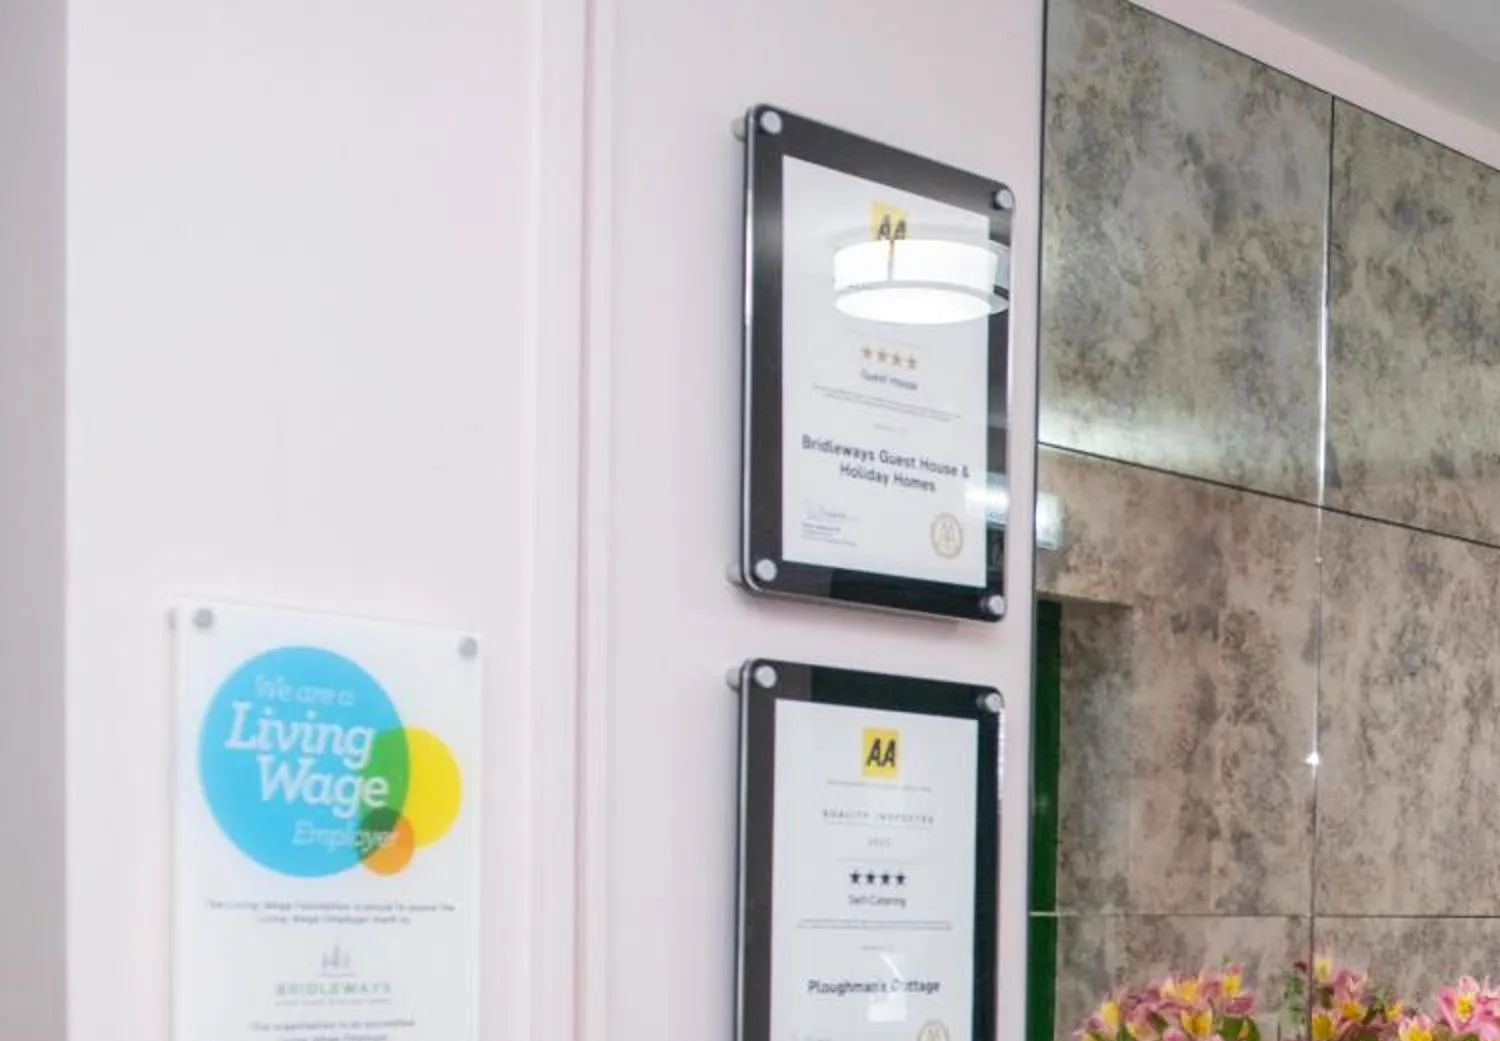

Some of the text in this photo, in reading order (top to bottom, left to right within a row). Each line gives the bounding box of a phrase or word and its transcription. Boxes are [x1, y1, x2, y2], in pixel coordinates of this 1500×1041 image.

[801, 433, 876, 463] Bridleways
[879, 449, 916, 470] Guest
[919, 457, 959, 477] House
[839, 463, 937, 493] Holiday Homes
[256, 675, 291, 703] We
[296, 686, 336, 704] are
[224, 701, 377, 770] Living
[866, 737, 897, 768] AA
[256, 753, 390, 818] Wage
[293, 820, 398, 852] Employer
[890, 977, 942, 996] Cttage
